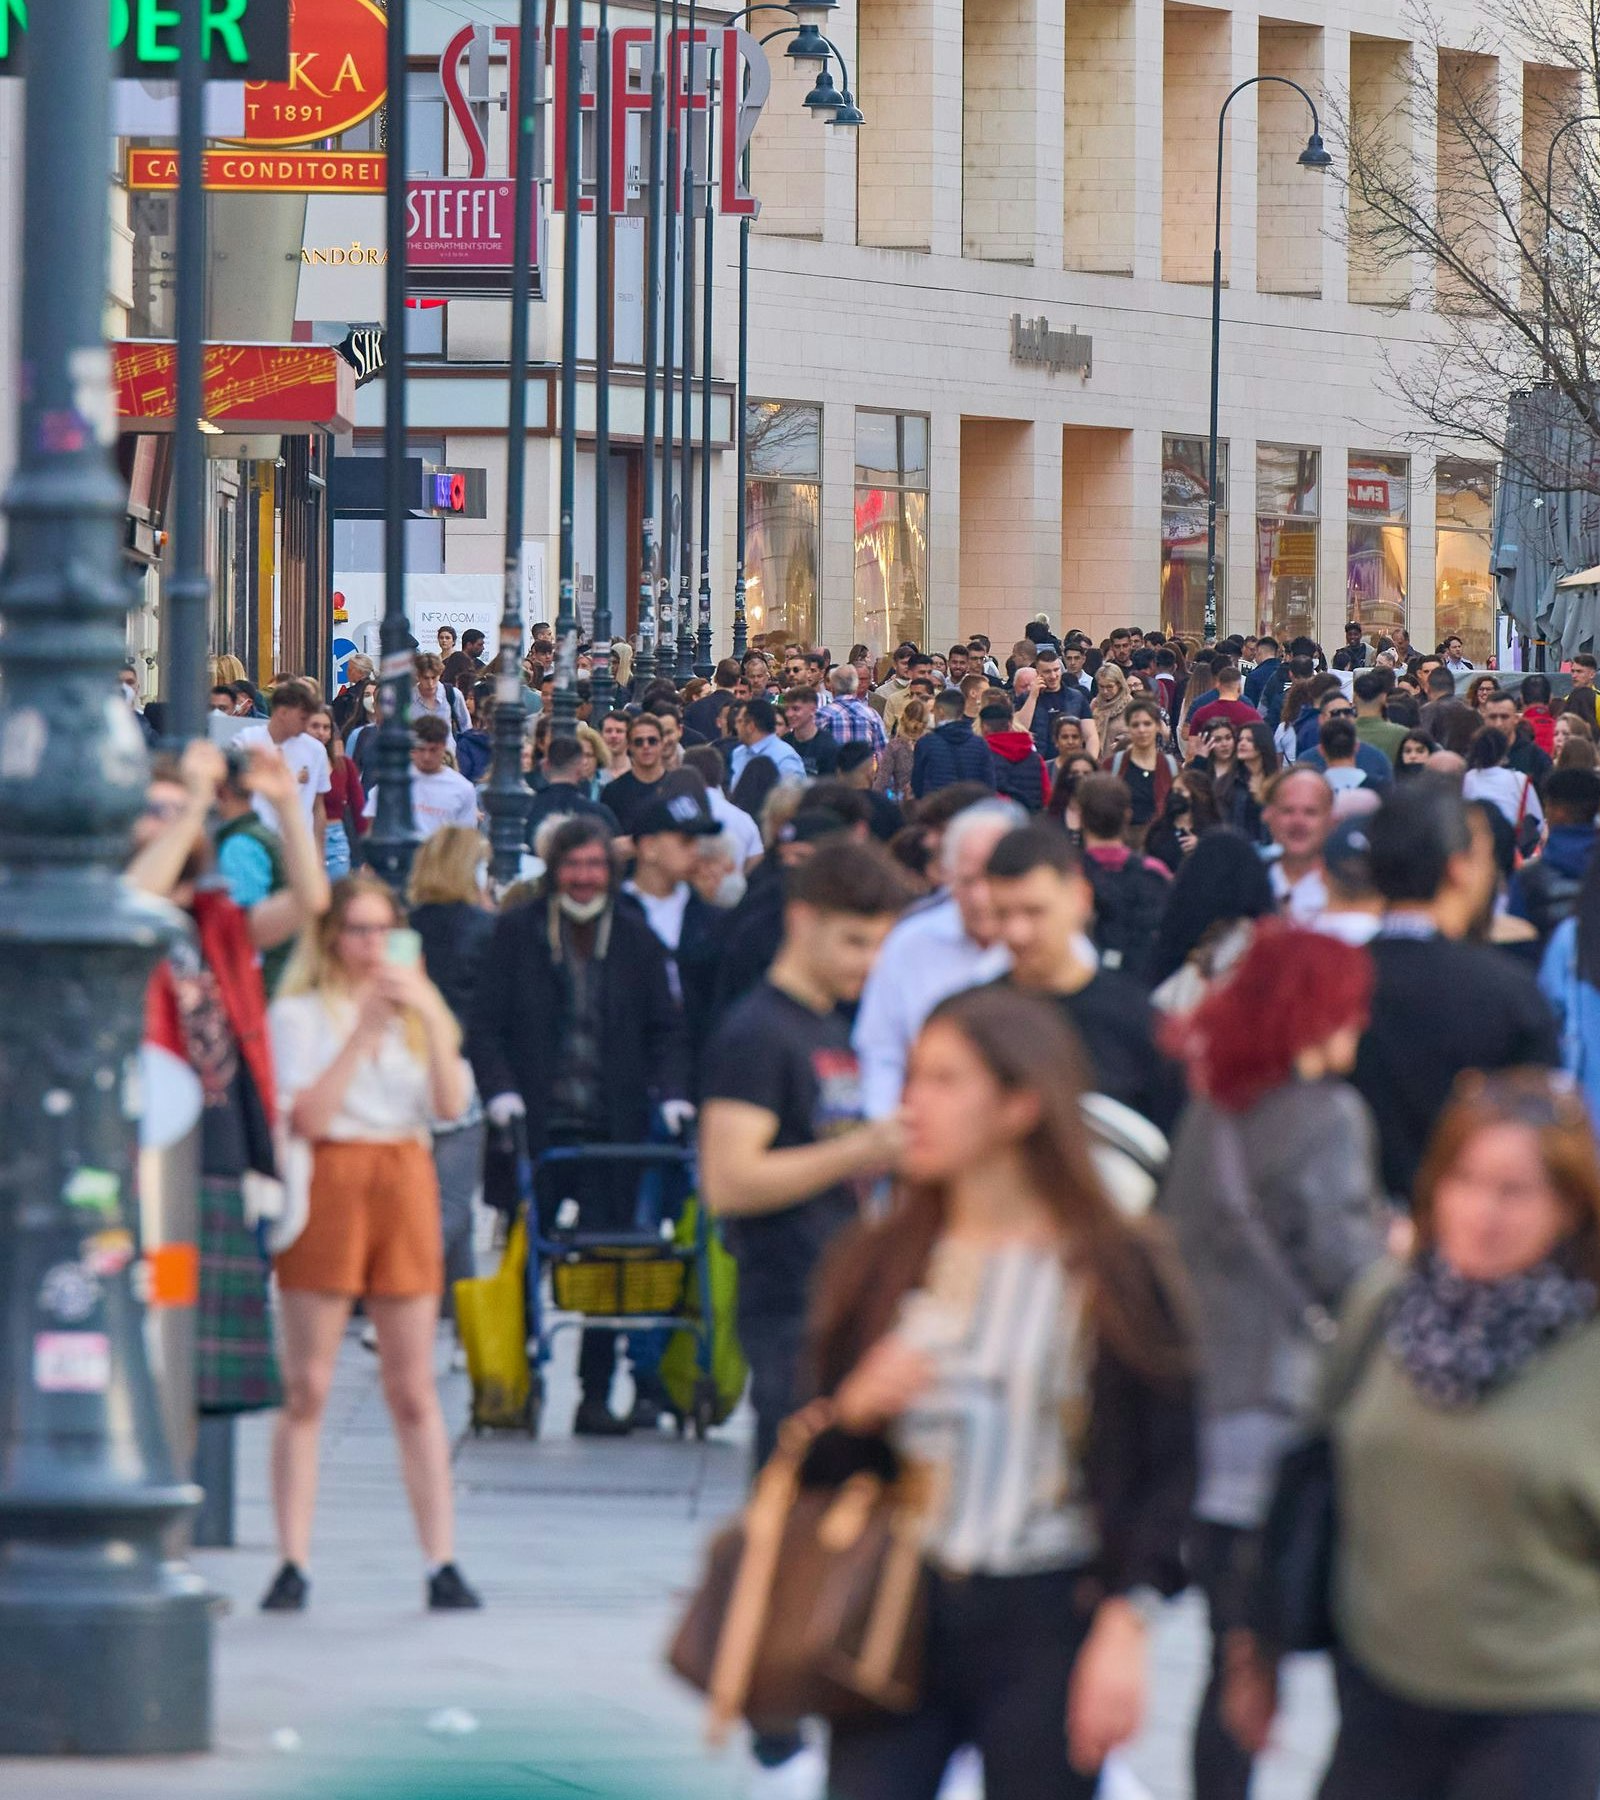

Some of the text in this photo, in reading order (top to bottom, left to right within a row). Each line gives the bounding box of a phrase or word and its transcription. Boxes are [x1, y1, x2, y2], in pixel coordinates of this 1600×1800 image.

[273, 105, 323, 122] 1891
[440, 22, 759, 215] STEFFL
[223, 160, 380, 181] CONDITOREI
[424, 242, 476, 250] DEPARTMENT
[477, 242, 503, 250] STORE
